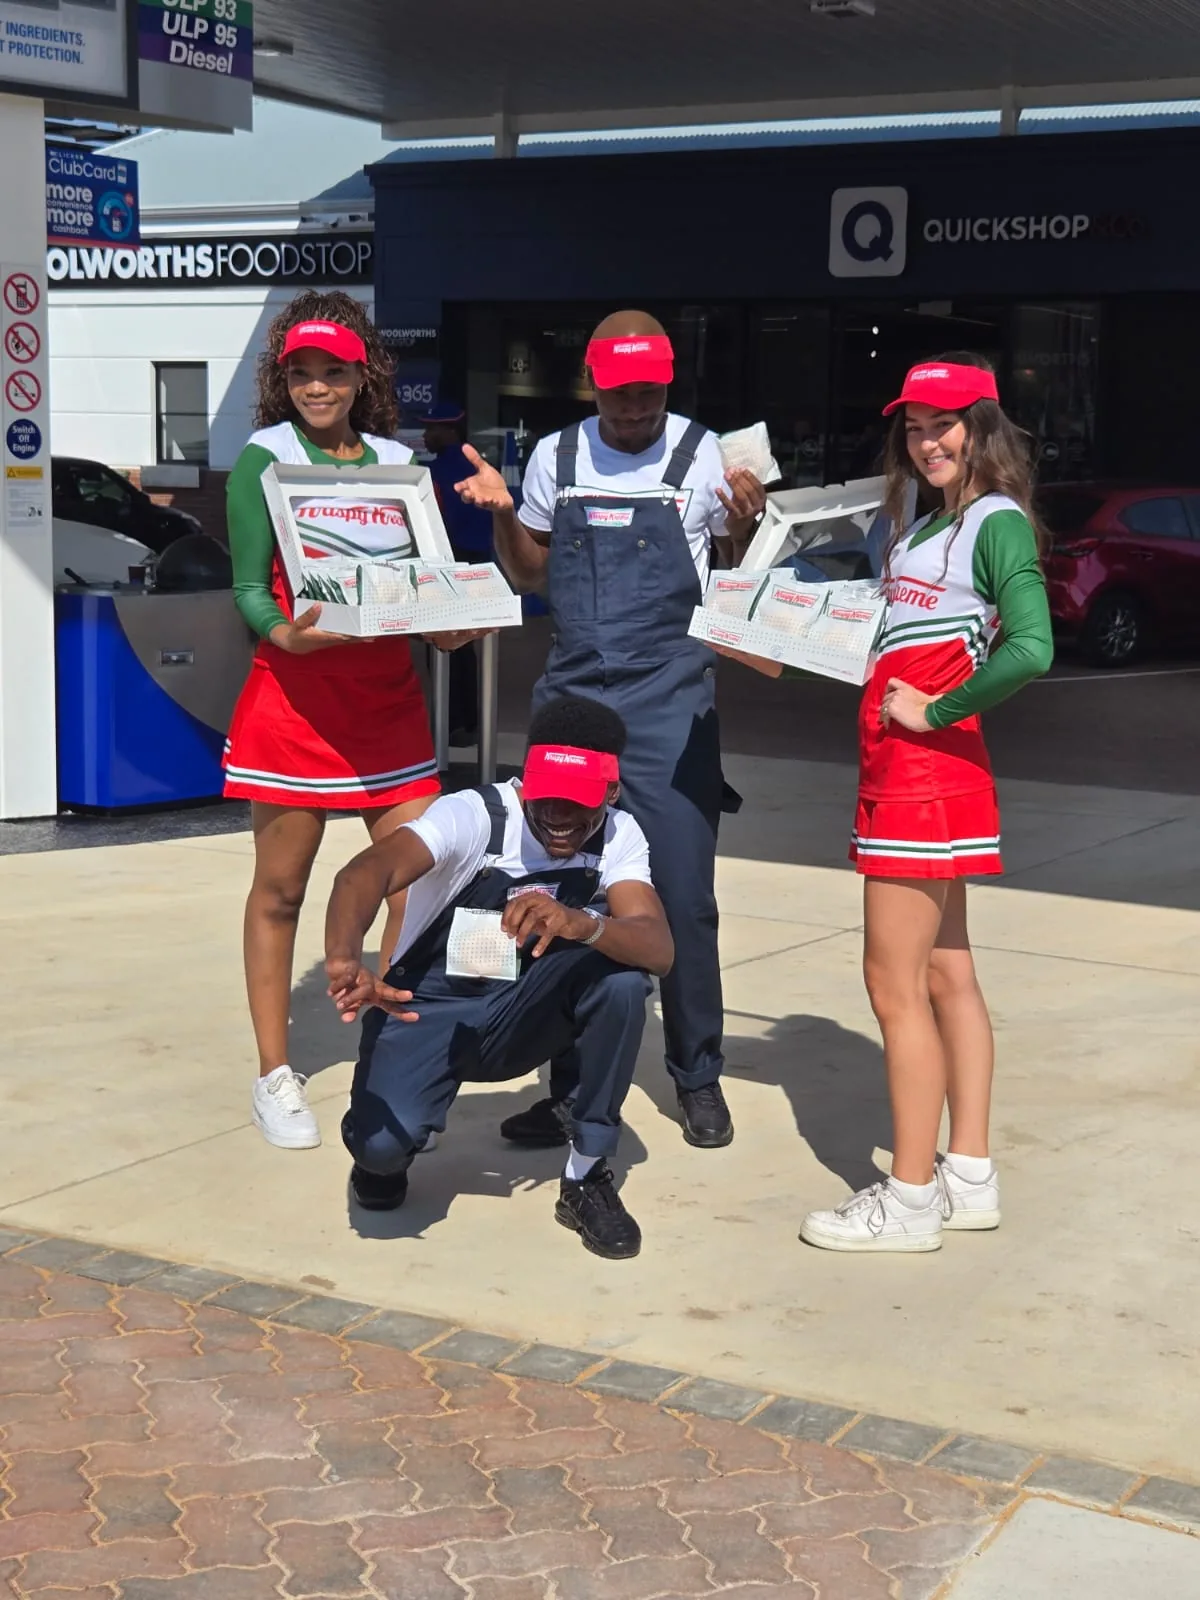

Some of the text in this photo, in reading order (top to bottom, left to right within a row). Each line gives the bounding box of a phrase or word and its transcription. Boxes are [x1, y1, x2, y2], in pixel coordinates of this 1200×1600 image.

[214, 0, 237, 20] 93
[6, 21, 85, 46] INGREDIENTS.
[162, 11, 237, 48] ULP 95
[8, 41, 84, 65] PROTECTION.
[170, 40, 233, 74] Diesel
[49, 158, 117, 181] ClubCard
[46, 184, 93, 203] more
[47, 208, 94, 227] more
[923, 215, 1090, 243] QUICKSHOP
[12, 425, 36, 434] Switch
[19, 434, 30, 443] Off
[12, 443, 36, 454] Engine
